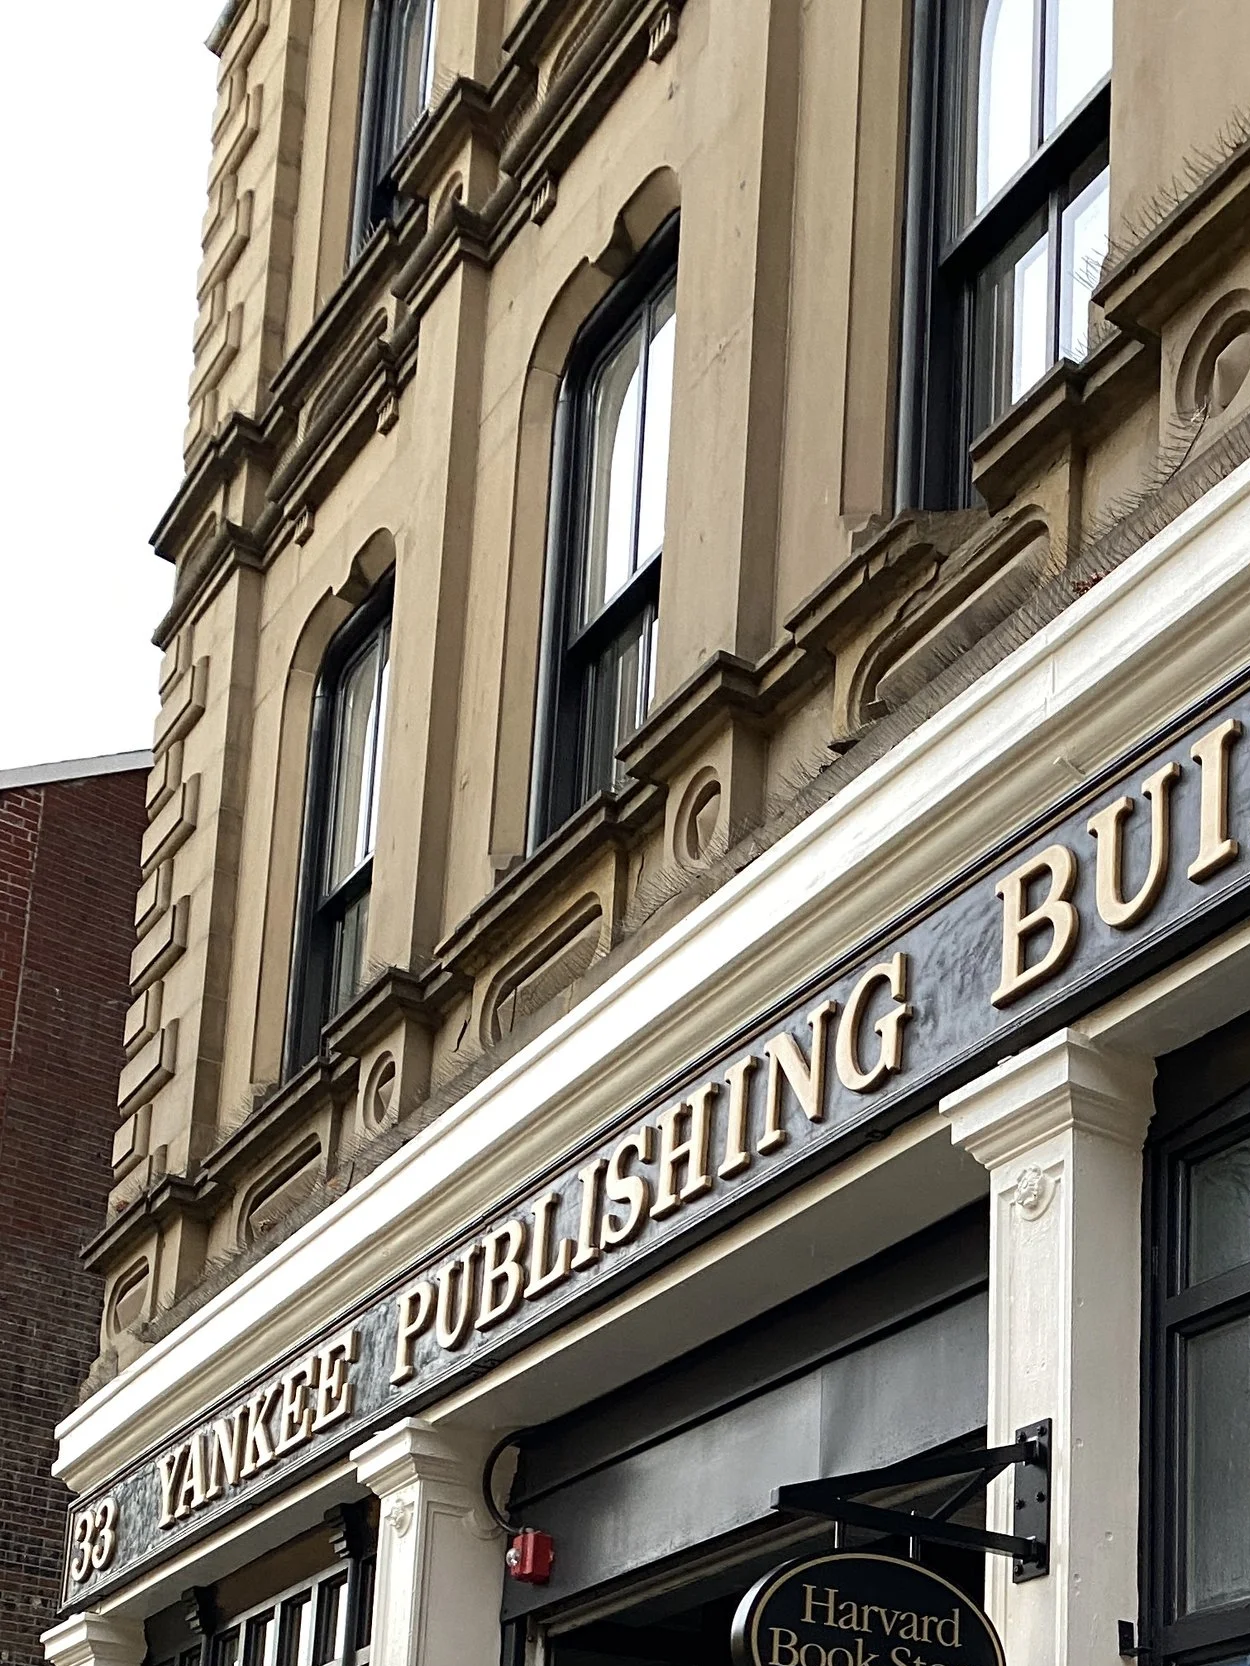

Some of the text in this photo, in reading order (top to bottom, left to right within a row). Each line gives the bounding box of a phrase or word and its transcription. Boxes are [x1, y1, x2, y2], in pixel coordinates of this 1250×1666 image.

[71, 1497, 119, 1583] 33
[156, 1330, 361, 1530] YANKEE
[390, 951, 913, 1386] PUBLISHING
[800, 1583, 962, 1648] Harvard
